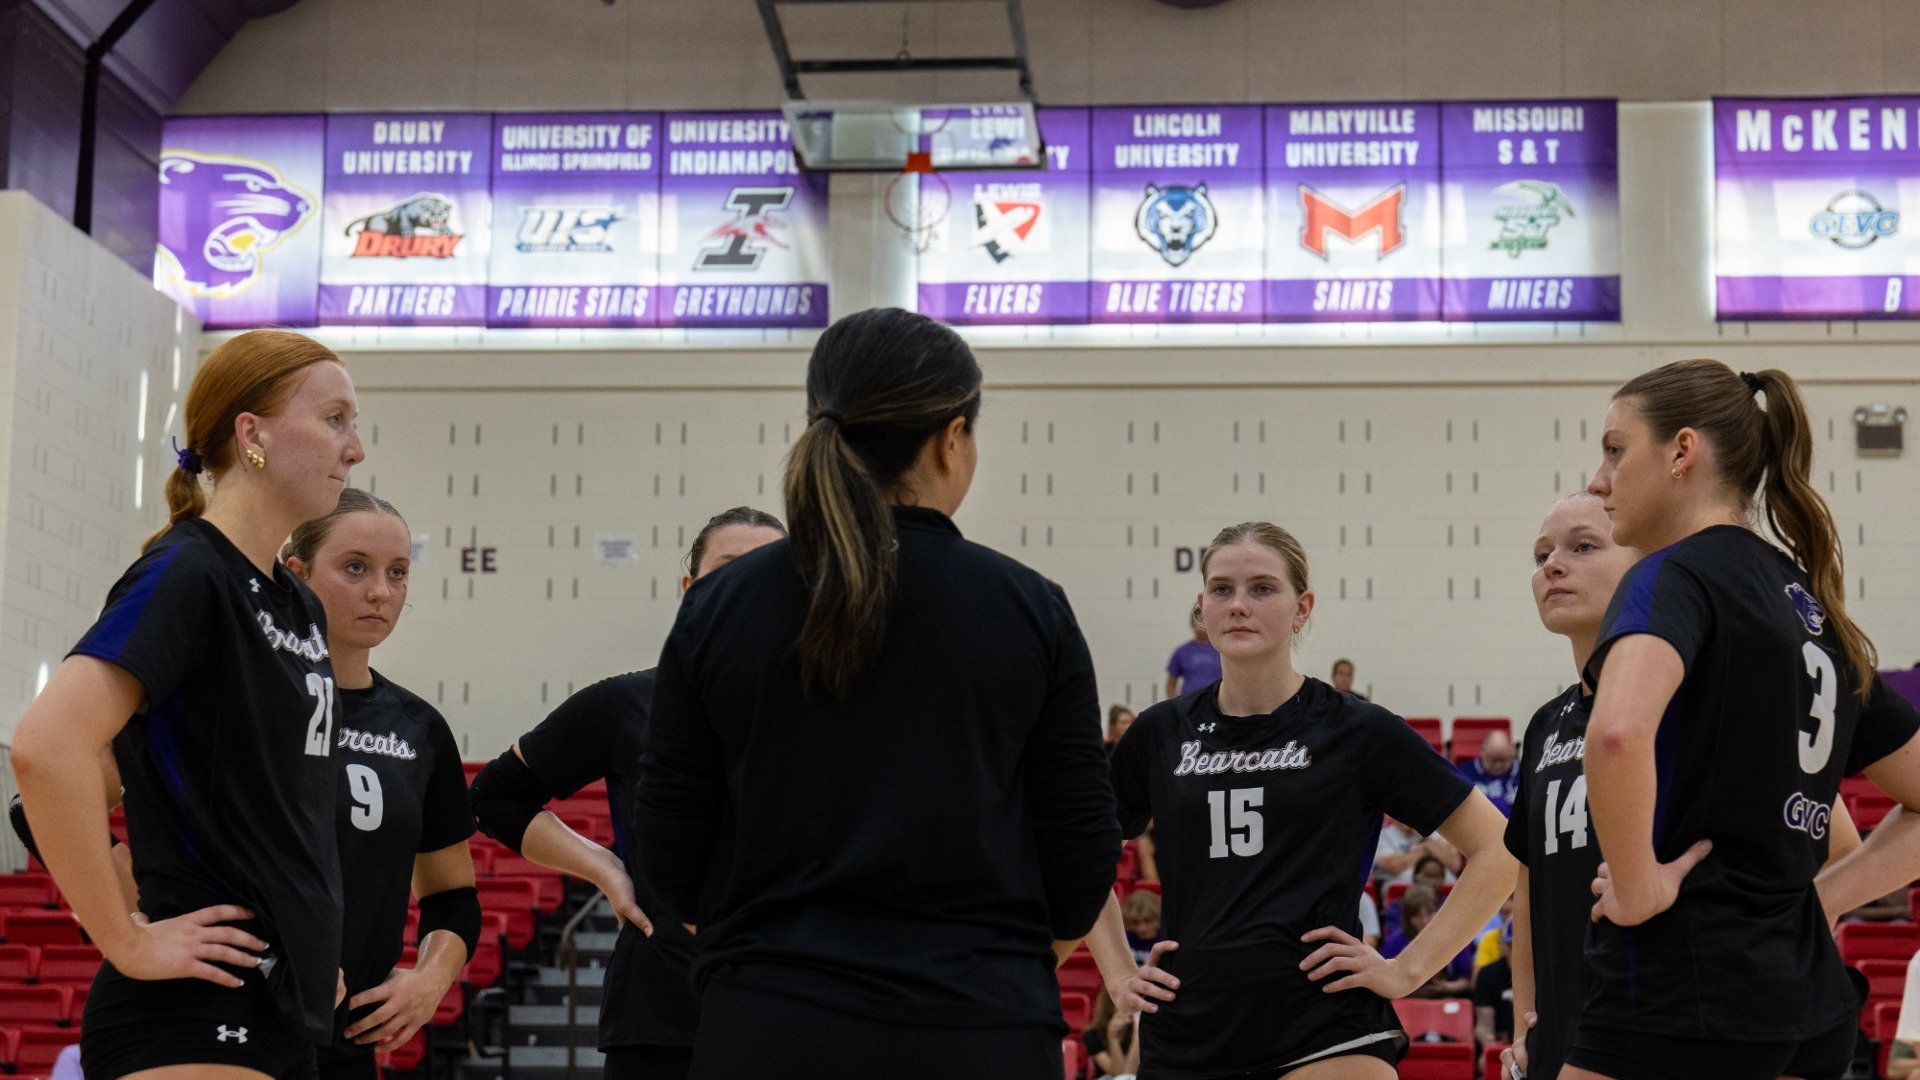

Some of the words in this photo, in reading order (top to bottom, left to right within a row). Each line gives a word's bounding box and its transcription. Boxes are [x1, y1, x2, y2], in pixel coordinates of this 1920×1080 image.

[373, 121, 445, 143] DRURY
[669, 120, 792, 143] UNIVERSITY
[1133, 113, 1221, 137] LINCOLN
[1289, 109, 1415, 135] MARYVILLE
[1473, 106, 1584, 133] MISSOURI
[1736, 108, 1920, 152] McKEN
[502, 125, 621, 149] UNIVERSITY
[626, 125, 652, 147] OF
[1498, 139, 1513, 164] S
[1520, 139, 1538, 164] &
[1545, 139, 1560, 164] T
[343, 151, 473, 174] UNIVERSITY
[502, 153, 560, 170] ILLINOIS
[562, 152, 651, 170] SPRINGFIELD
[670, 150, 800, 175] INDIANAPOL
[1115, 143, 1239, 167] UNIVERSITY
[1285, 141, 1419, 167] UNIVERSITY
[1809, 209, 1900, 237] GLVC
[351, 230, 464, 258] DRURY
[347, 286, 457, 316] PANTHERS
[497, 288, 581, 317] PRAIRIE
[584, 288, 649, 317] STARS
[673, 287, 812, 316] GREYHOUNDS
[964, 284, 1043, 314] FLYERS
[1106, 282, 1162, 312] BLUE
[1169, 281, 1246, 312] TIGERS
[1313, 281, 1393, 311] SAINTS
[1487, 279, 1573, 309] MINERS
[461, 547, 497, 573] EE
[304, 673, 334, 757] 21
[1798, 641, 1837, 774] 3
[337, 727, 417, 760] rcats
[1174, 739, 1311, 776] Bearcats
[1535, 730, 1587, 773] Bear
[346, 763, 383, 831] 9
[1208, 787, 1264, 858] 15
[1545, 774, 1588, 855] 14
